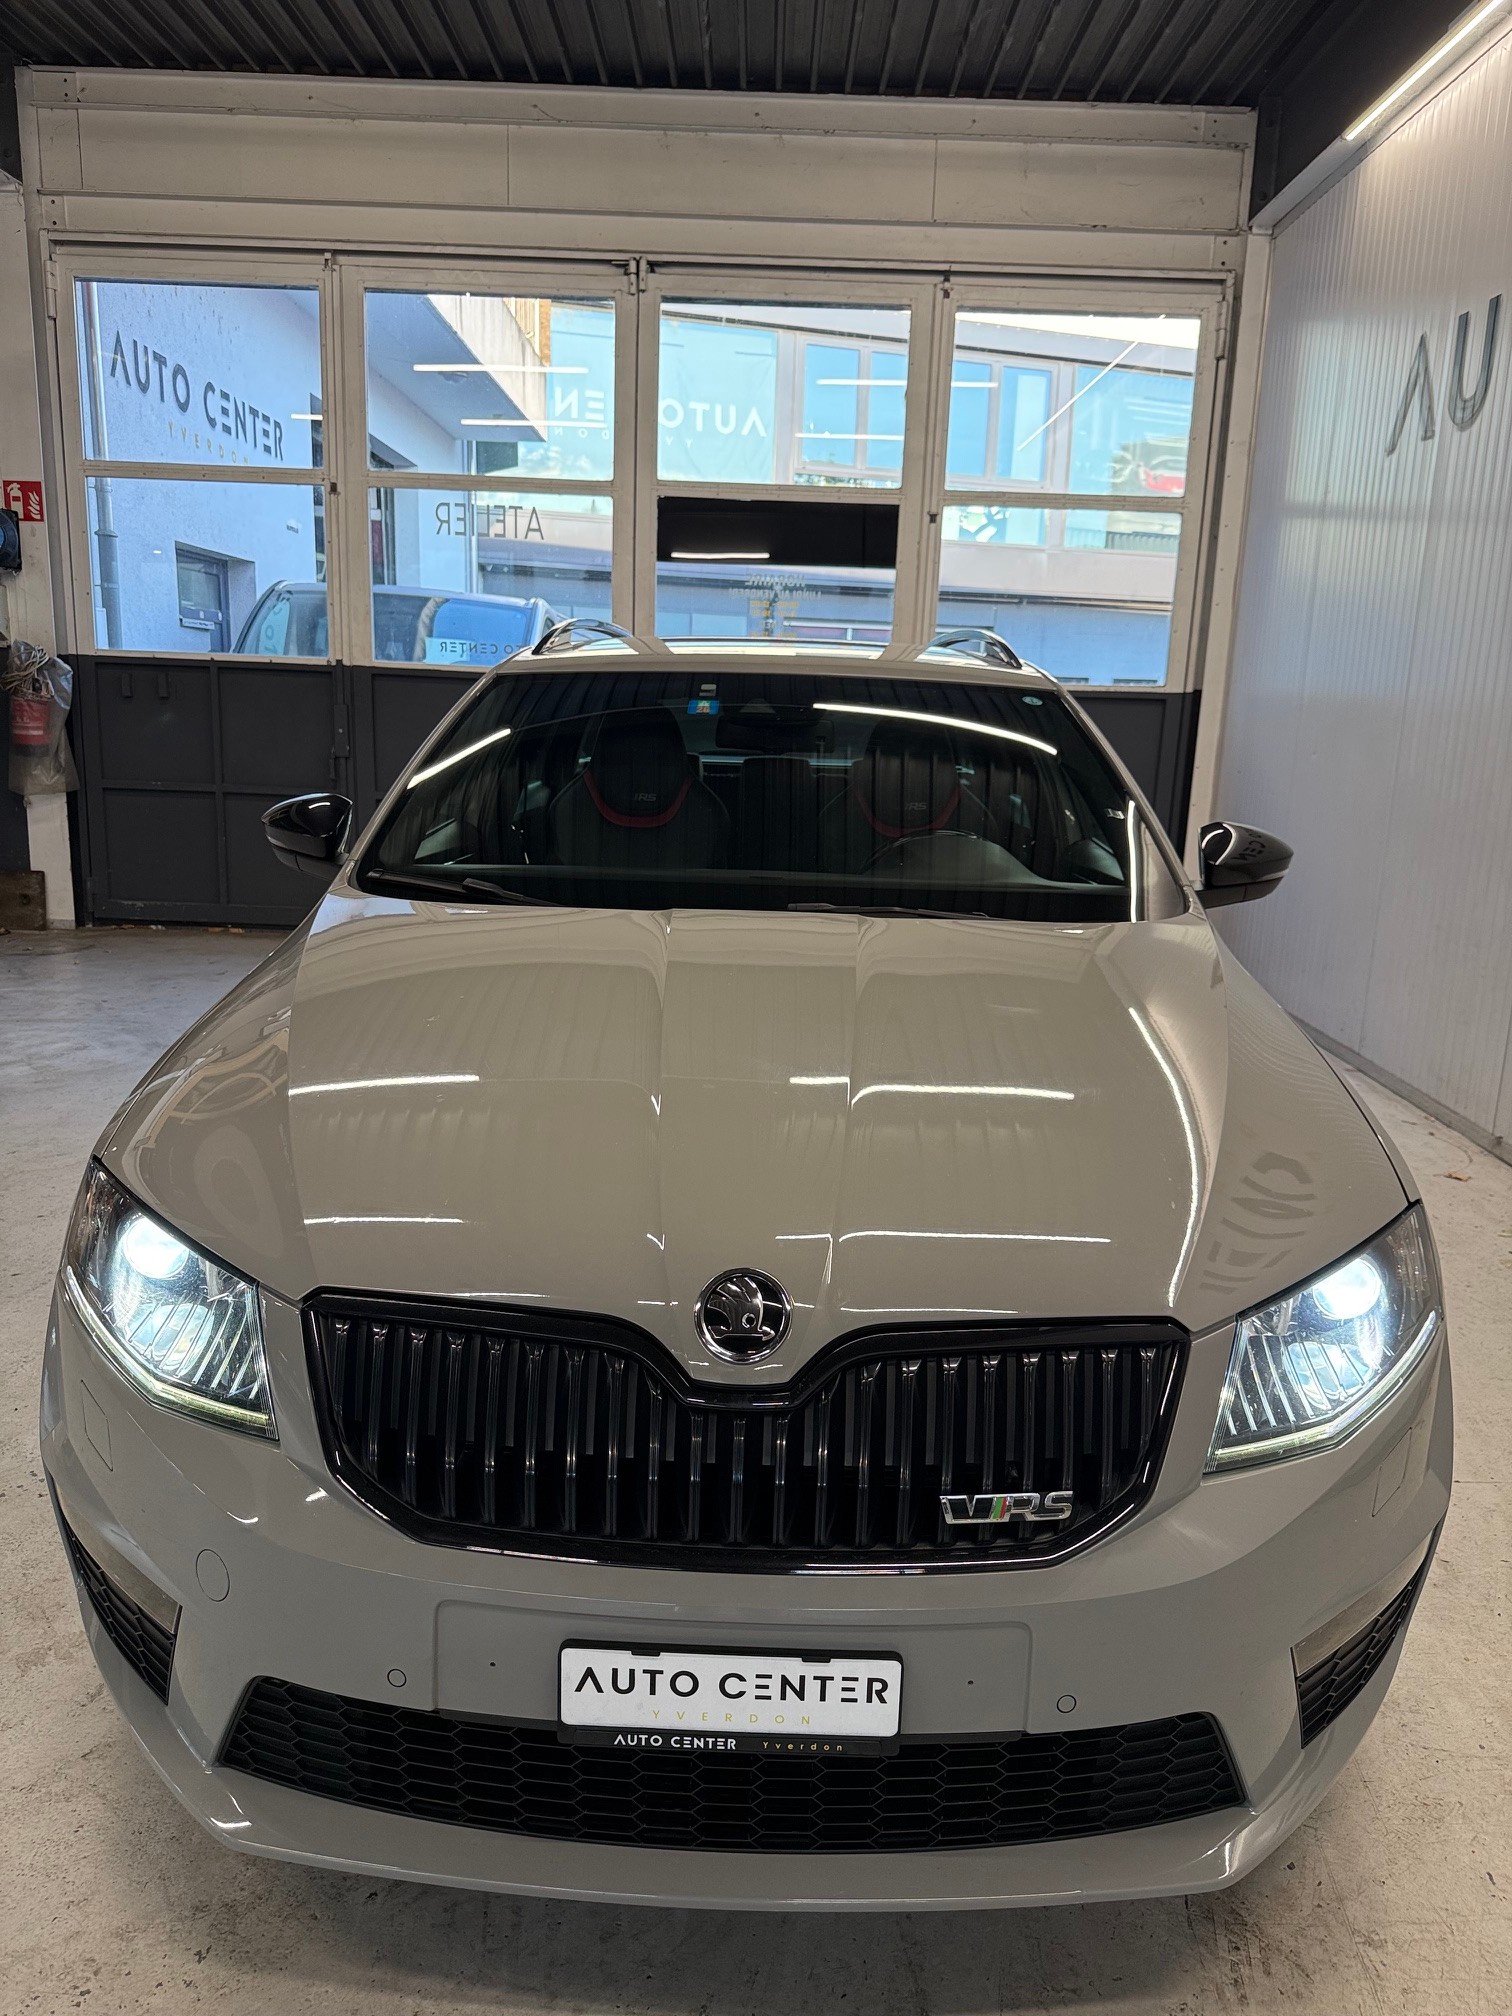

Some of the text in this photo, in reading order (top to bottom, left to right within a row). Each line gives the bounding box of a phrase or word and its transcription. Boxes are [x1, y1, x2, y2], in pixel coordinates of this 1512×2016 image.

[110, 330, 284, 462] AUTO CENTER
[168, 418, 249, 464] YVERDON
[574, 1666, 888, 1704] AUTO CENTER
[652, 1709, 811, 1725] YVERDON
[613, 1734, 844, 1752] AUTO CENTER Yverdon
